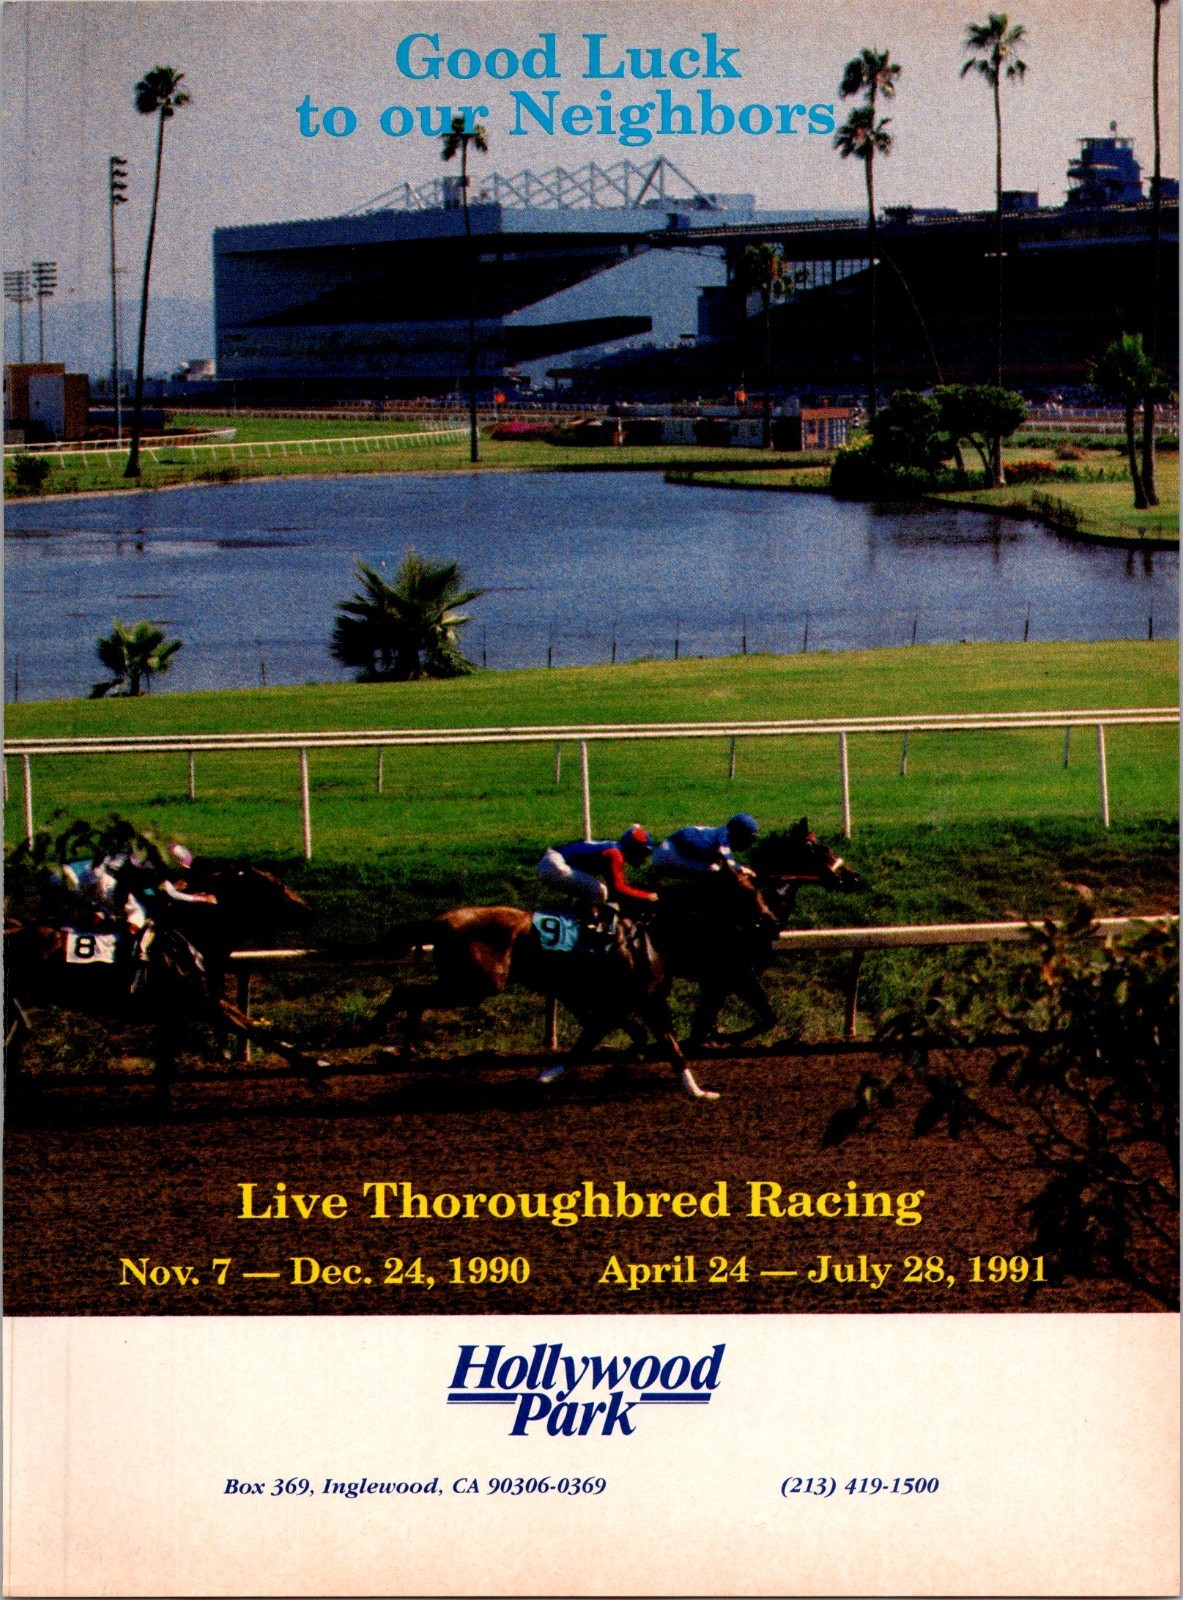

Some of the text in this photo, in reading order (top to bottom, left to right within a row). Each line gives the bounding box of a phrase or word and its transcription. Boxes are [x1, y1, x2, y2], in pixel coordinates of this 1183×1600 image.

[396, 32, 742, 81] Good Luck
[297, 88, 836, 147] to our Neighbors
[75, 936, 96, 958] 8
[541, 917, 560, 946] 9
[238, 1180, 926, 1228] Live Thoroughbred Racing
[120, 1257, 199, 1287] Nov.
[212, 1257, 233, 1287] 7
[290, 1257, 372, 1287] Dec.
[384, 1257, 436, 1291] 24,
[448, 1256, 532, 1286] 1990
[598, 1255, 698, 1292] April
[708, 1256, 750, 1285] 24
[807, 1254, 893, 1291] July
[902, 1255, 956, 1289] 28,
[969, 1255, 1047, 1284] 1991
[449, 1343, 726, 1403] Hollywood
[508, 1393, 639, 1437] Park
[224, 1476, 607, 1499] Box 369, Inglewood, CA 90306-0369
[781, 1476, 940, 1498] (213) 419-1500
